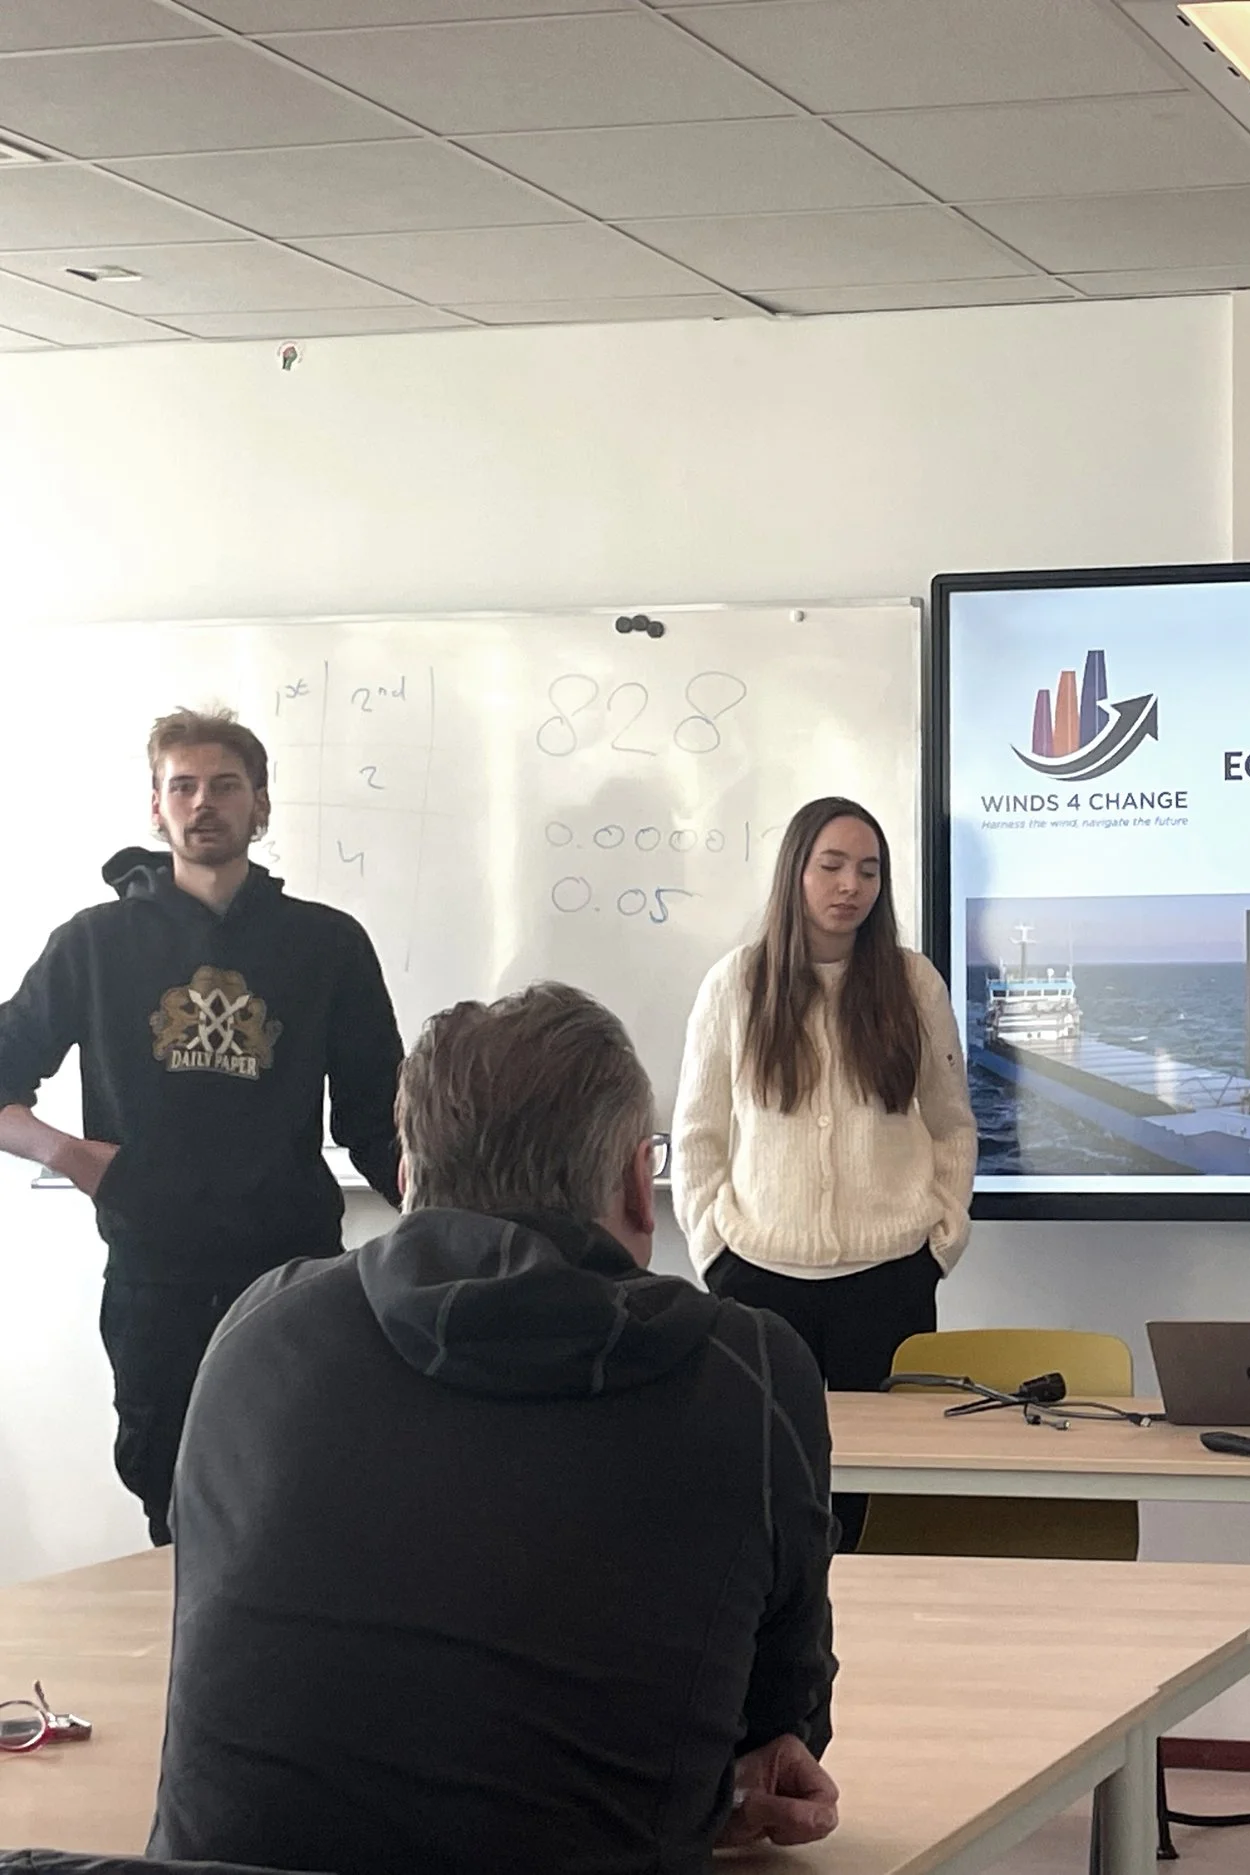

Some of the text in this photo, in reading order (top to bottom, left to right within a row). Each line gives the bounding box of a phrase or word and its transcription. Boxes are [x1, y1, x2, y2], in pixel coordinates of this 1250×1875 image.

[351, 675, 406, 713] 2nd
[536, 671, 748, 757] 828
[359, 765, 386, 790] 2
[981, 790, 1189, 814] WINDS 4 CHANGE
[981, 815, 1189, 831] Harness the wind, navigate the future
[171, 1050, 257, 1077] DAILY PAPER
